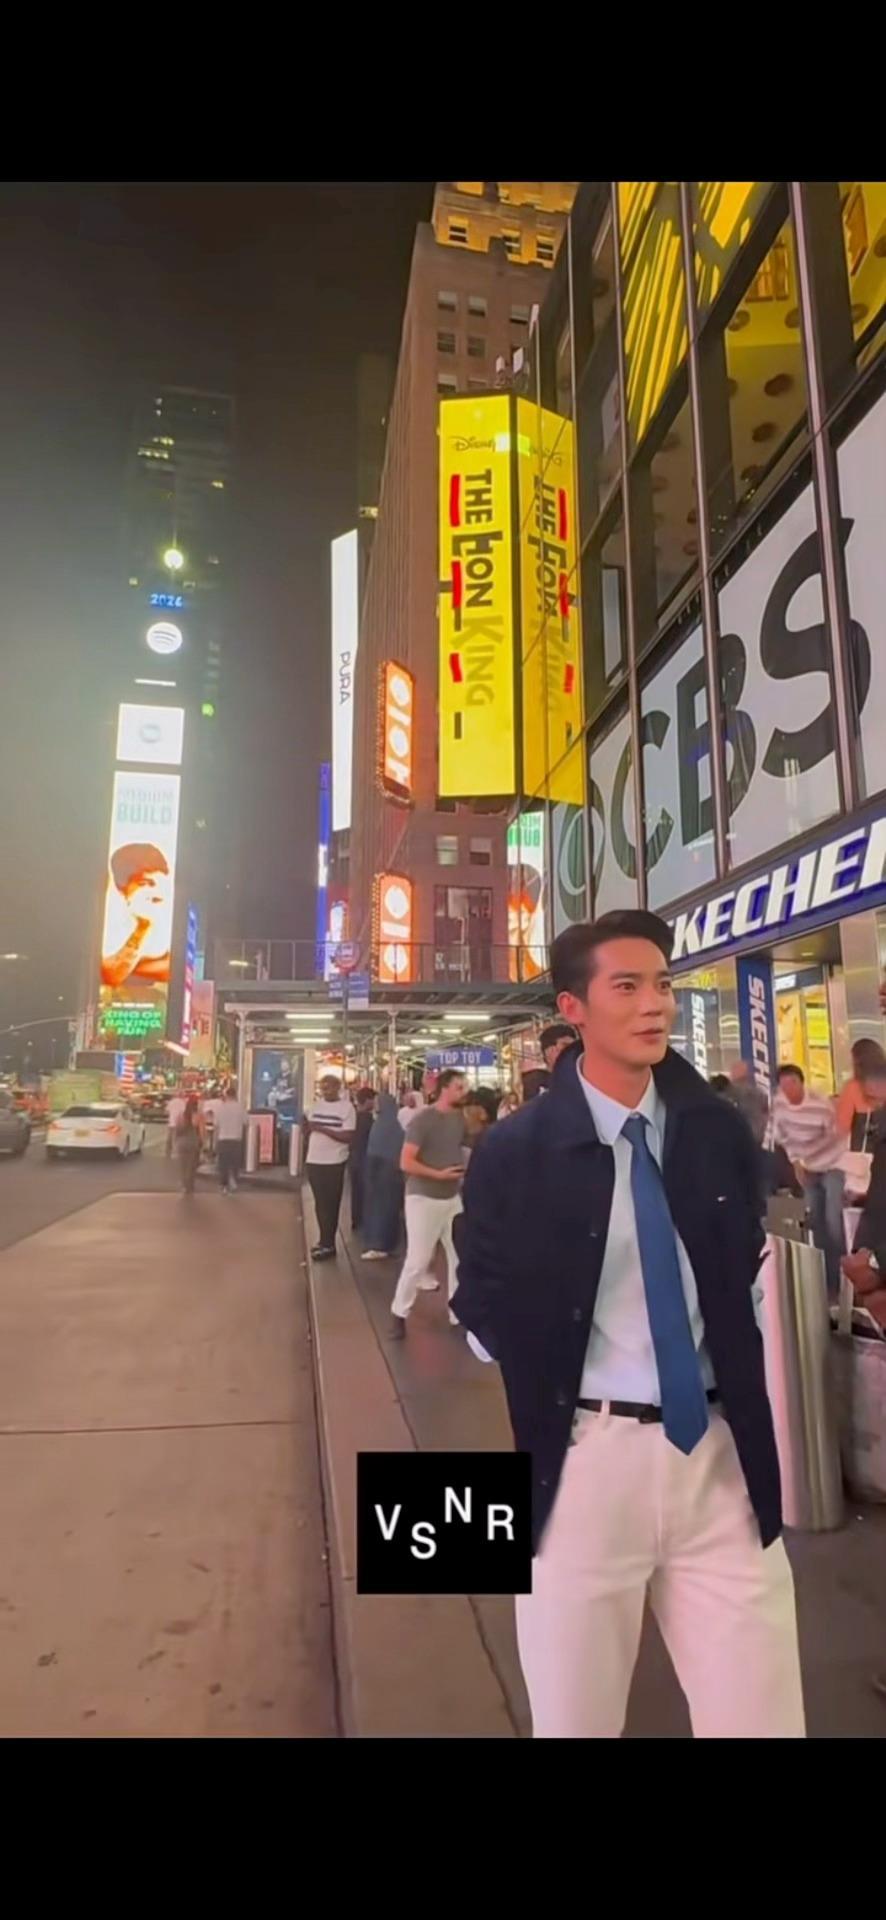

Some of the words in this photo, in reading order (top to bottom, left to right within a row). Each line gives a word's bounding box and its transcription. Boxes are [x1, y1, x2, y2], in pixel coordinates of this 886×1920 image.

[465, 468, 492, 524] THE
[151, 594, 182, 607] 2026
[340, 651, 350, 705] PURA
[450, 615, 504, 706] KING
[611, 518, 871, 880] CBS
[118, 803, 173, 824] BUILD
[668, 818, 886, 961] KECHE
[440, 1051, 459, 1064] TOP
[461, 1051, 481, 1064] TOY
